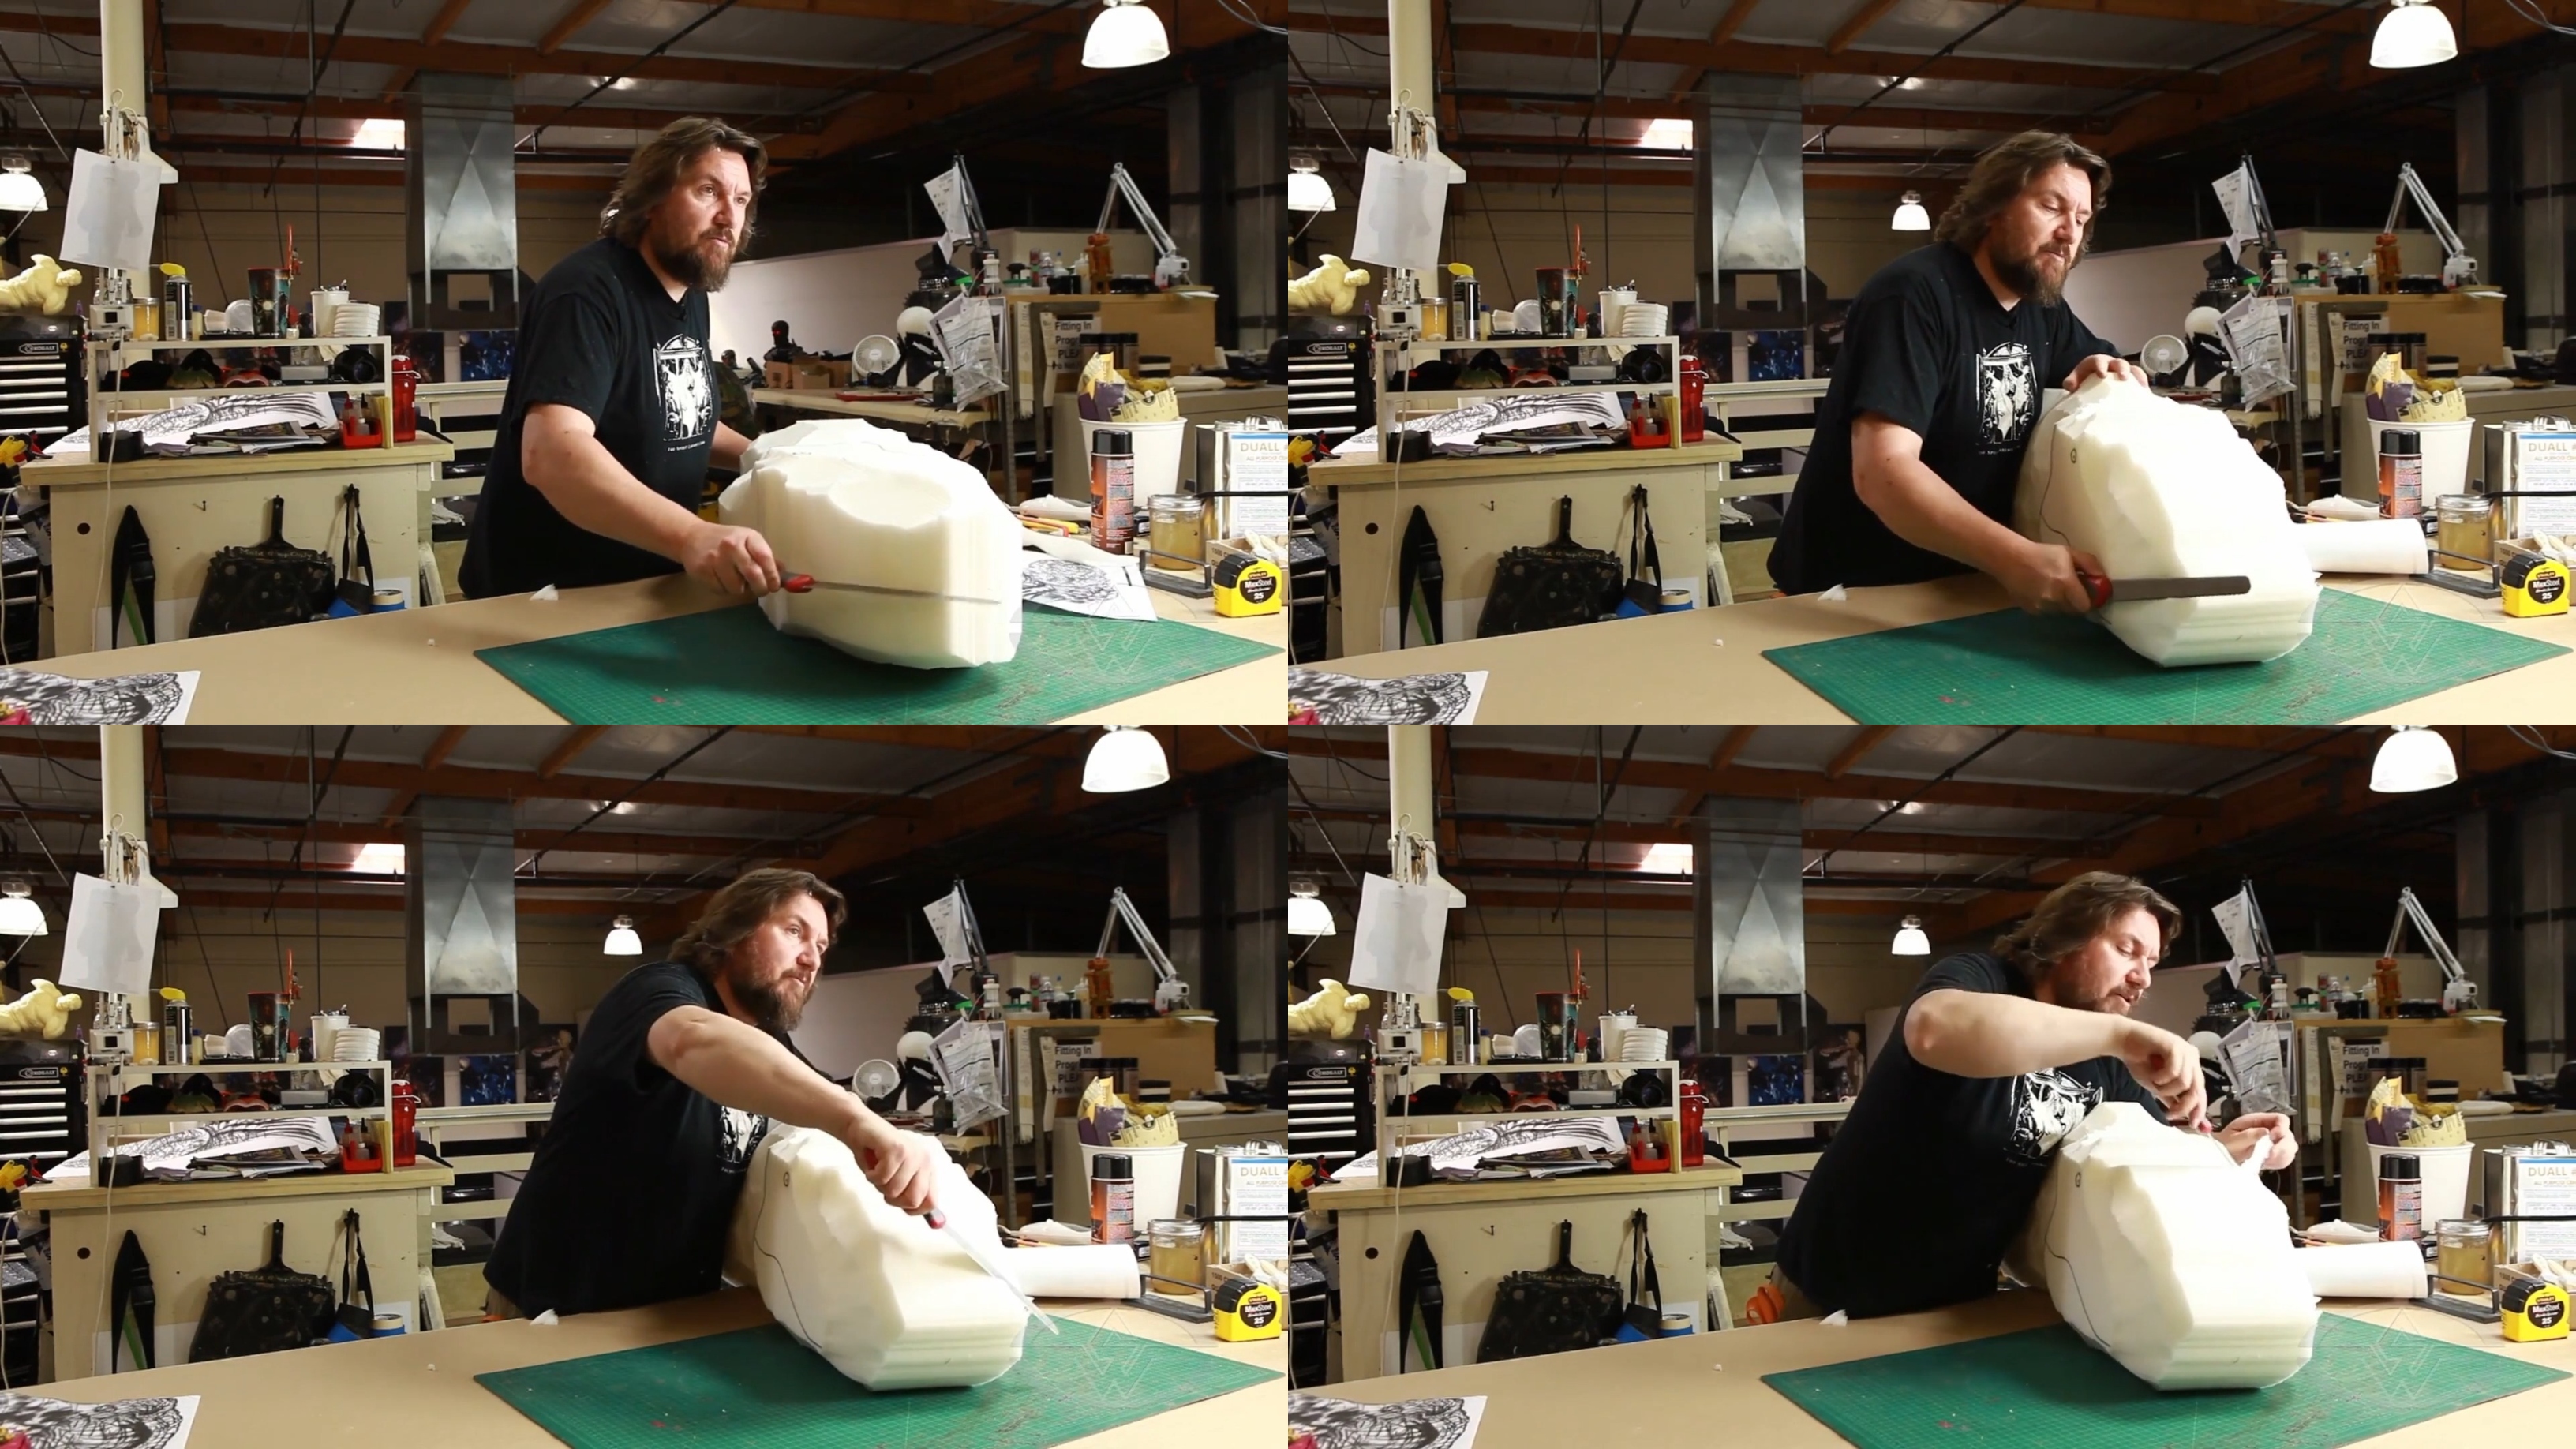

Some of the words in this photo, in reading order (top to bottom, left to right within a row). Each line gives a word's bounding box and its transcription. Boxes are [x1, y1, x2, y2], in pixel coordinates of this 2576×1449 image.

[1055, 322, 1081, 332] Fitting
[1084, 321, 1092, 330] In
[2343, 322, 2369, 332] Fitting
[2372, 321, 2380, 330] In
[1241, 442, 1279, 452] DUALL
[2529, 442, 2567, 452] DUALL
[1055, 1046, 1081, 1057] Fitting
[1084, 1046, 1092, 1054] In
[2343, 1046, 2369, 1057] Fitting
[2372, 1046, 2380, 1054] In
[1241, 1166, 1279, 1177] DUALL
[2529, 1166, 2567, 1177] DUALL
